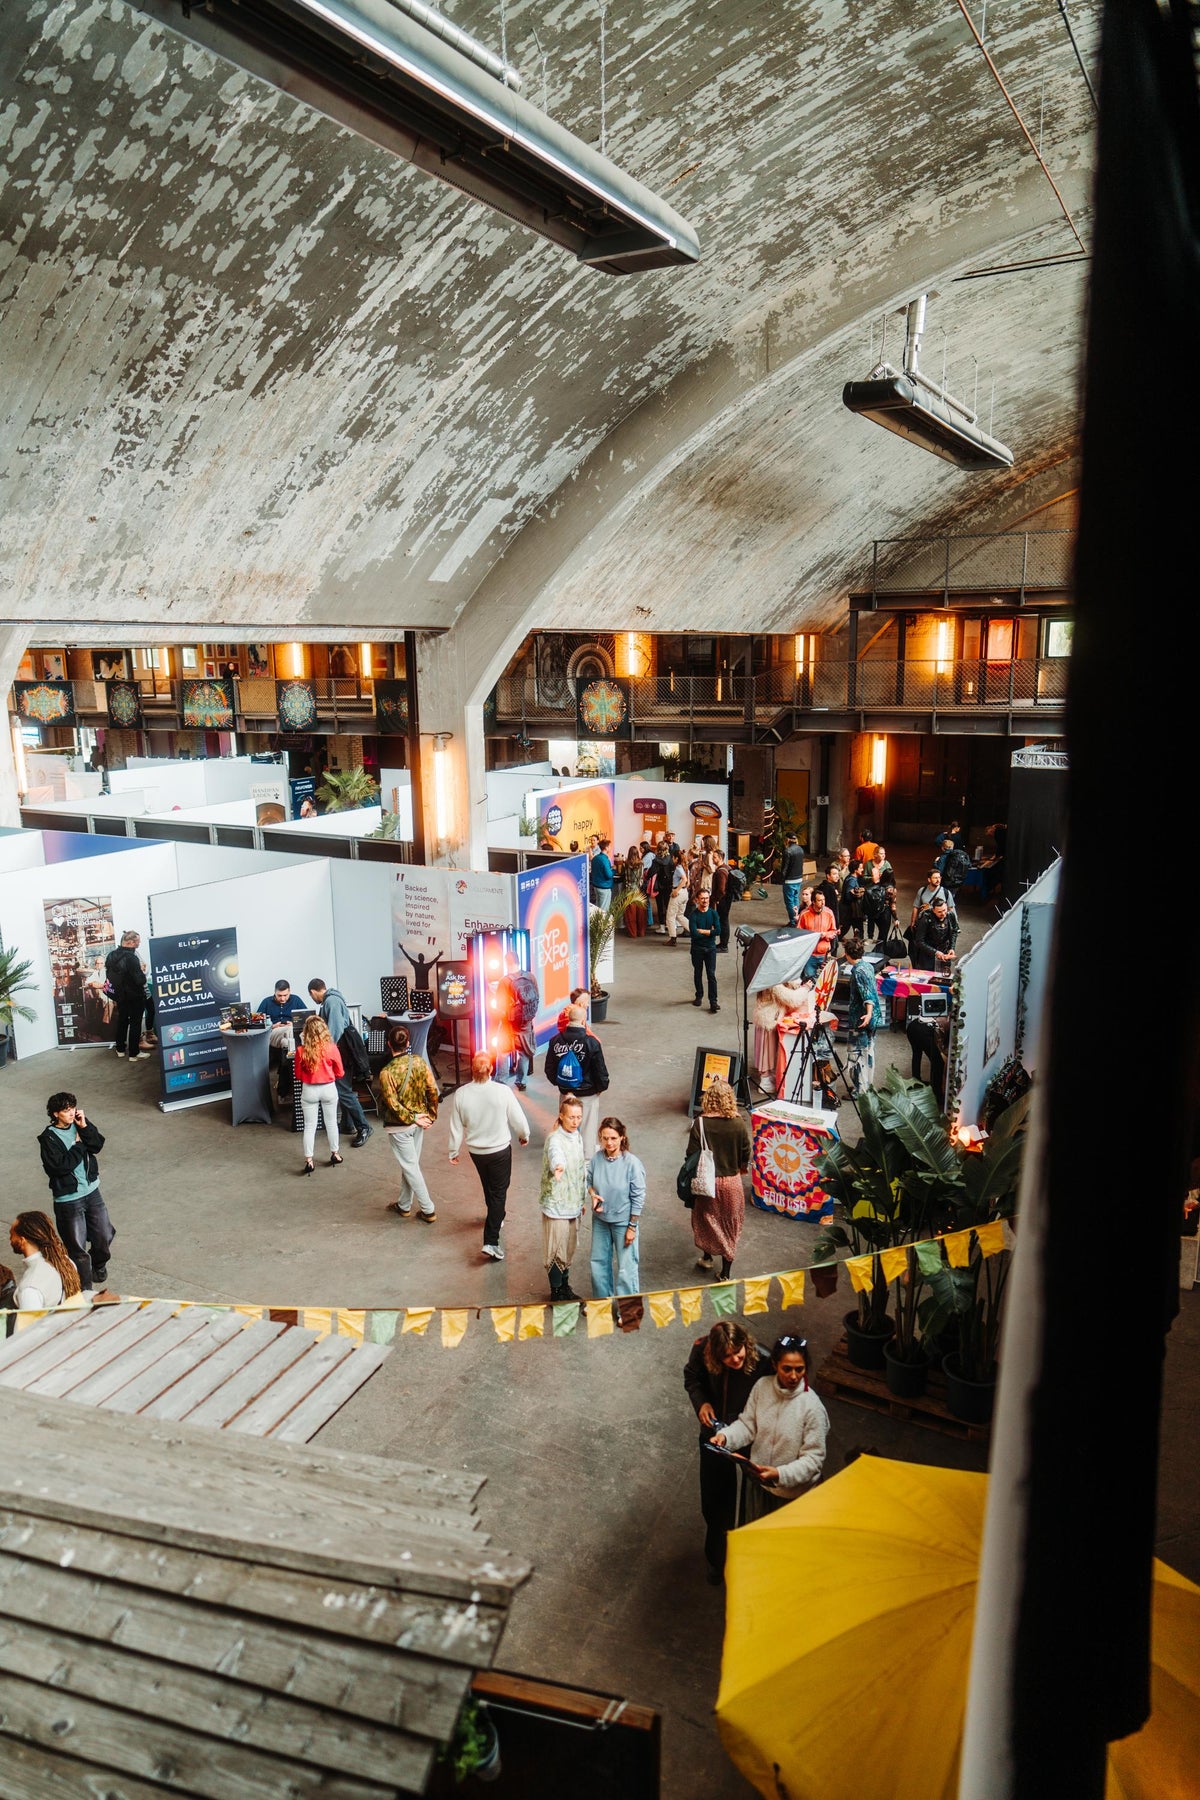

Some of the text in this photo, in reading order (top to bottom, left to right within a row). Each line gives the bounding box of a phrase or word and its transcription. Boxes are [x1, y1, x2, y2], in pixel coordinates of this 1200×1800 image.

[574, 818, 594, 831] happy
[404, 884, 428, 893] Backed
[405, 893, 439, 904] by science,
[405, 902, 430, 910] inspired
[415, 912, 436, 921] nature,
[67, 919, 108, 927] Foundation
[406, 919, 421, 927] lived
[178, 939, 201, 948] ELIOS
[530, 928, 560, 953] TRYP
[538, 941, 569, 968] EXPO
[155, 959, 210, 973] LA TERAPIA
[156, 972, 187, 983] DELLA
[158, 978, 203, 998] LUCE
[168, 995, 193, 1006] CASA
[195, 991, 214, 1001] TUA
[186, 1021, 221, 1033] EVOLUTAM
[763, 1189, 807, 1213] FAIR LSD
